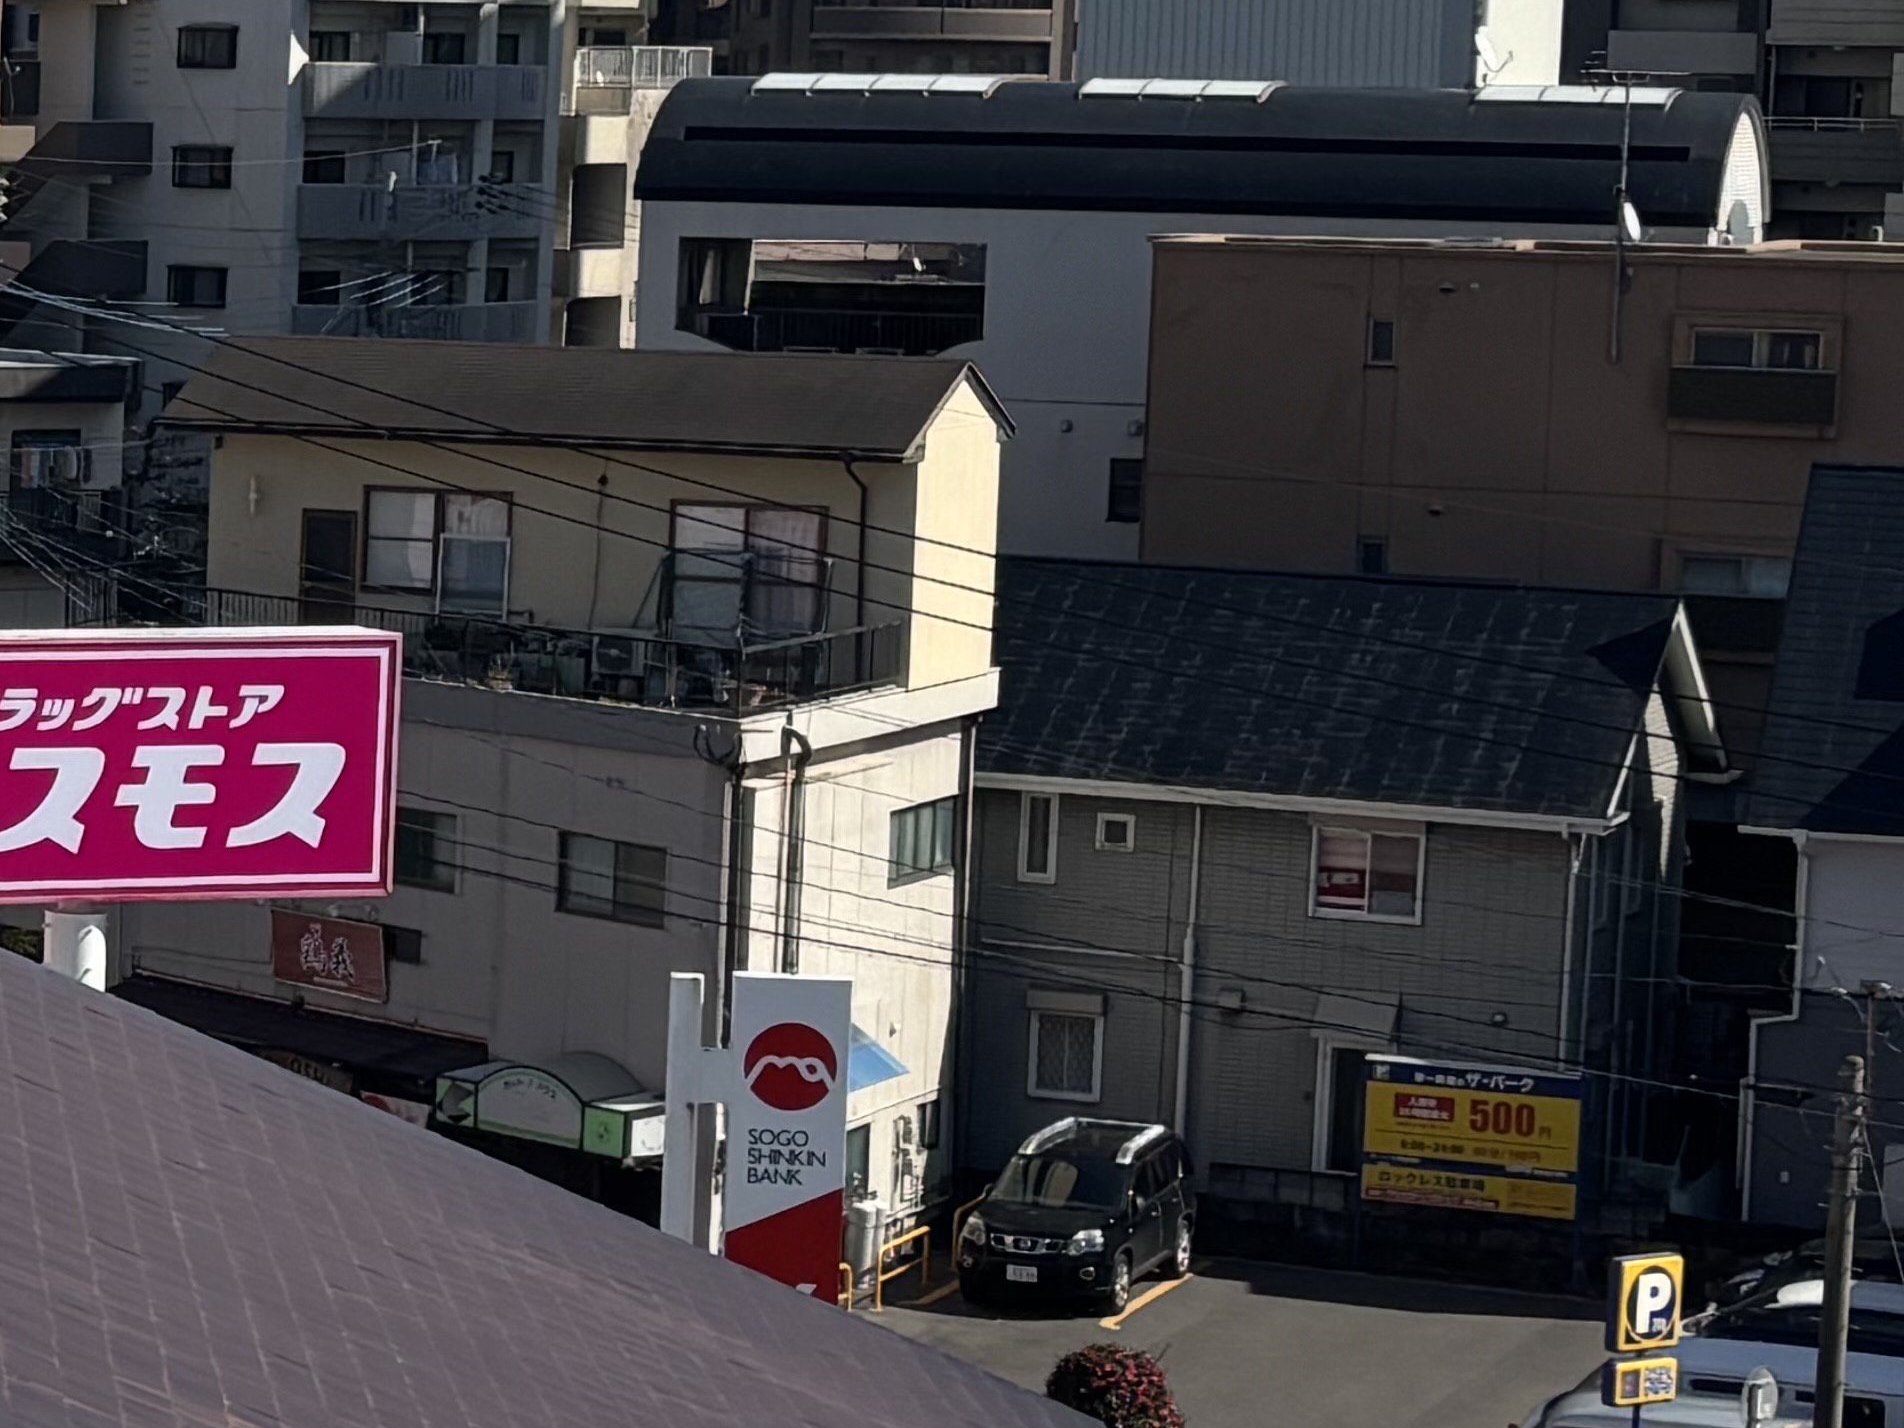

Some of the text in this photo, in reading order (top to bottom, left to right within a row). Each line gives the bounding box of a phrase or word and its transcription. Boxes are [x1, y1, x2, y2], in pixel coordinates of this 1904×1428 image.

[748, 1128, 809, 1147] SOGO
[748, 1148, 826, 1167] SHINKIN
[747, 1168, 802, 1185] BANK
[1635, 1273, 1672, 1334] P
